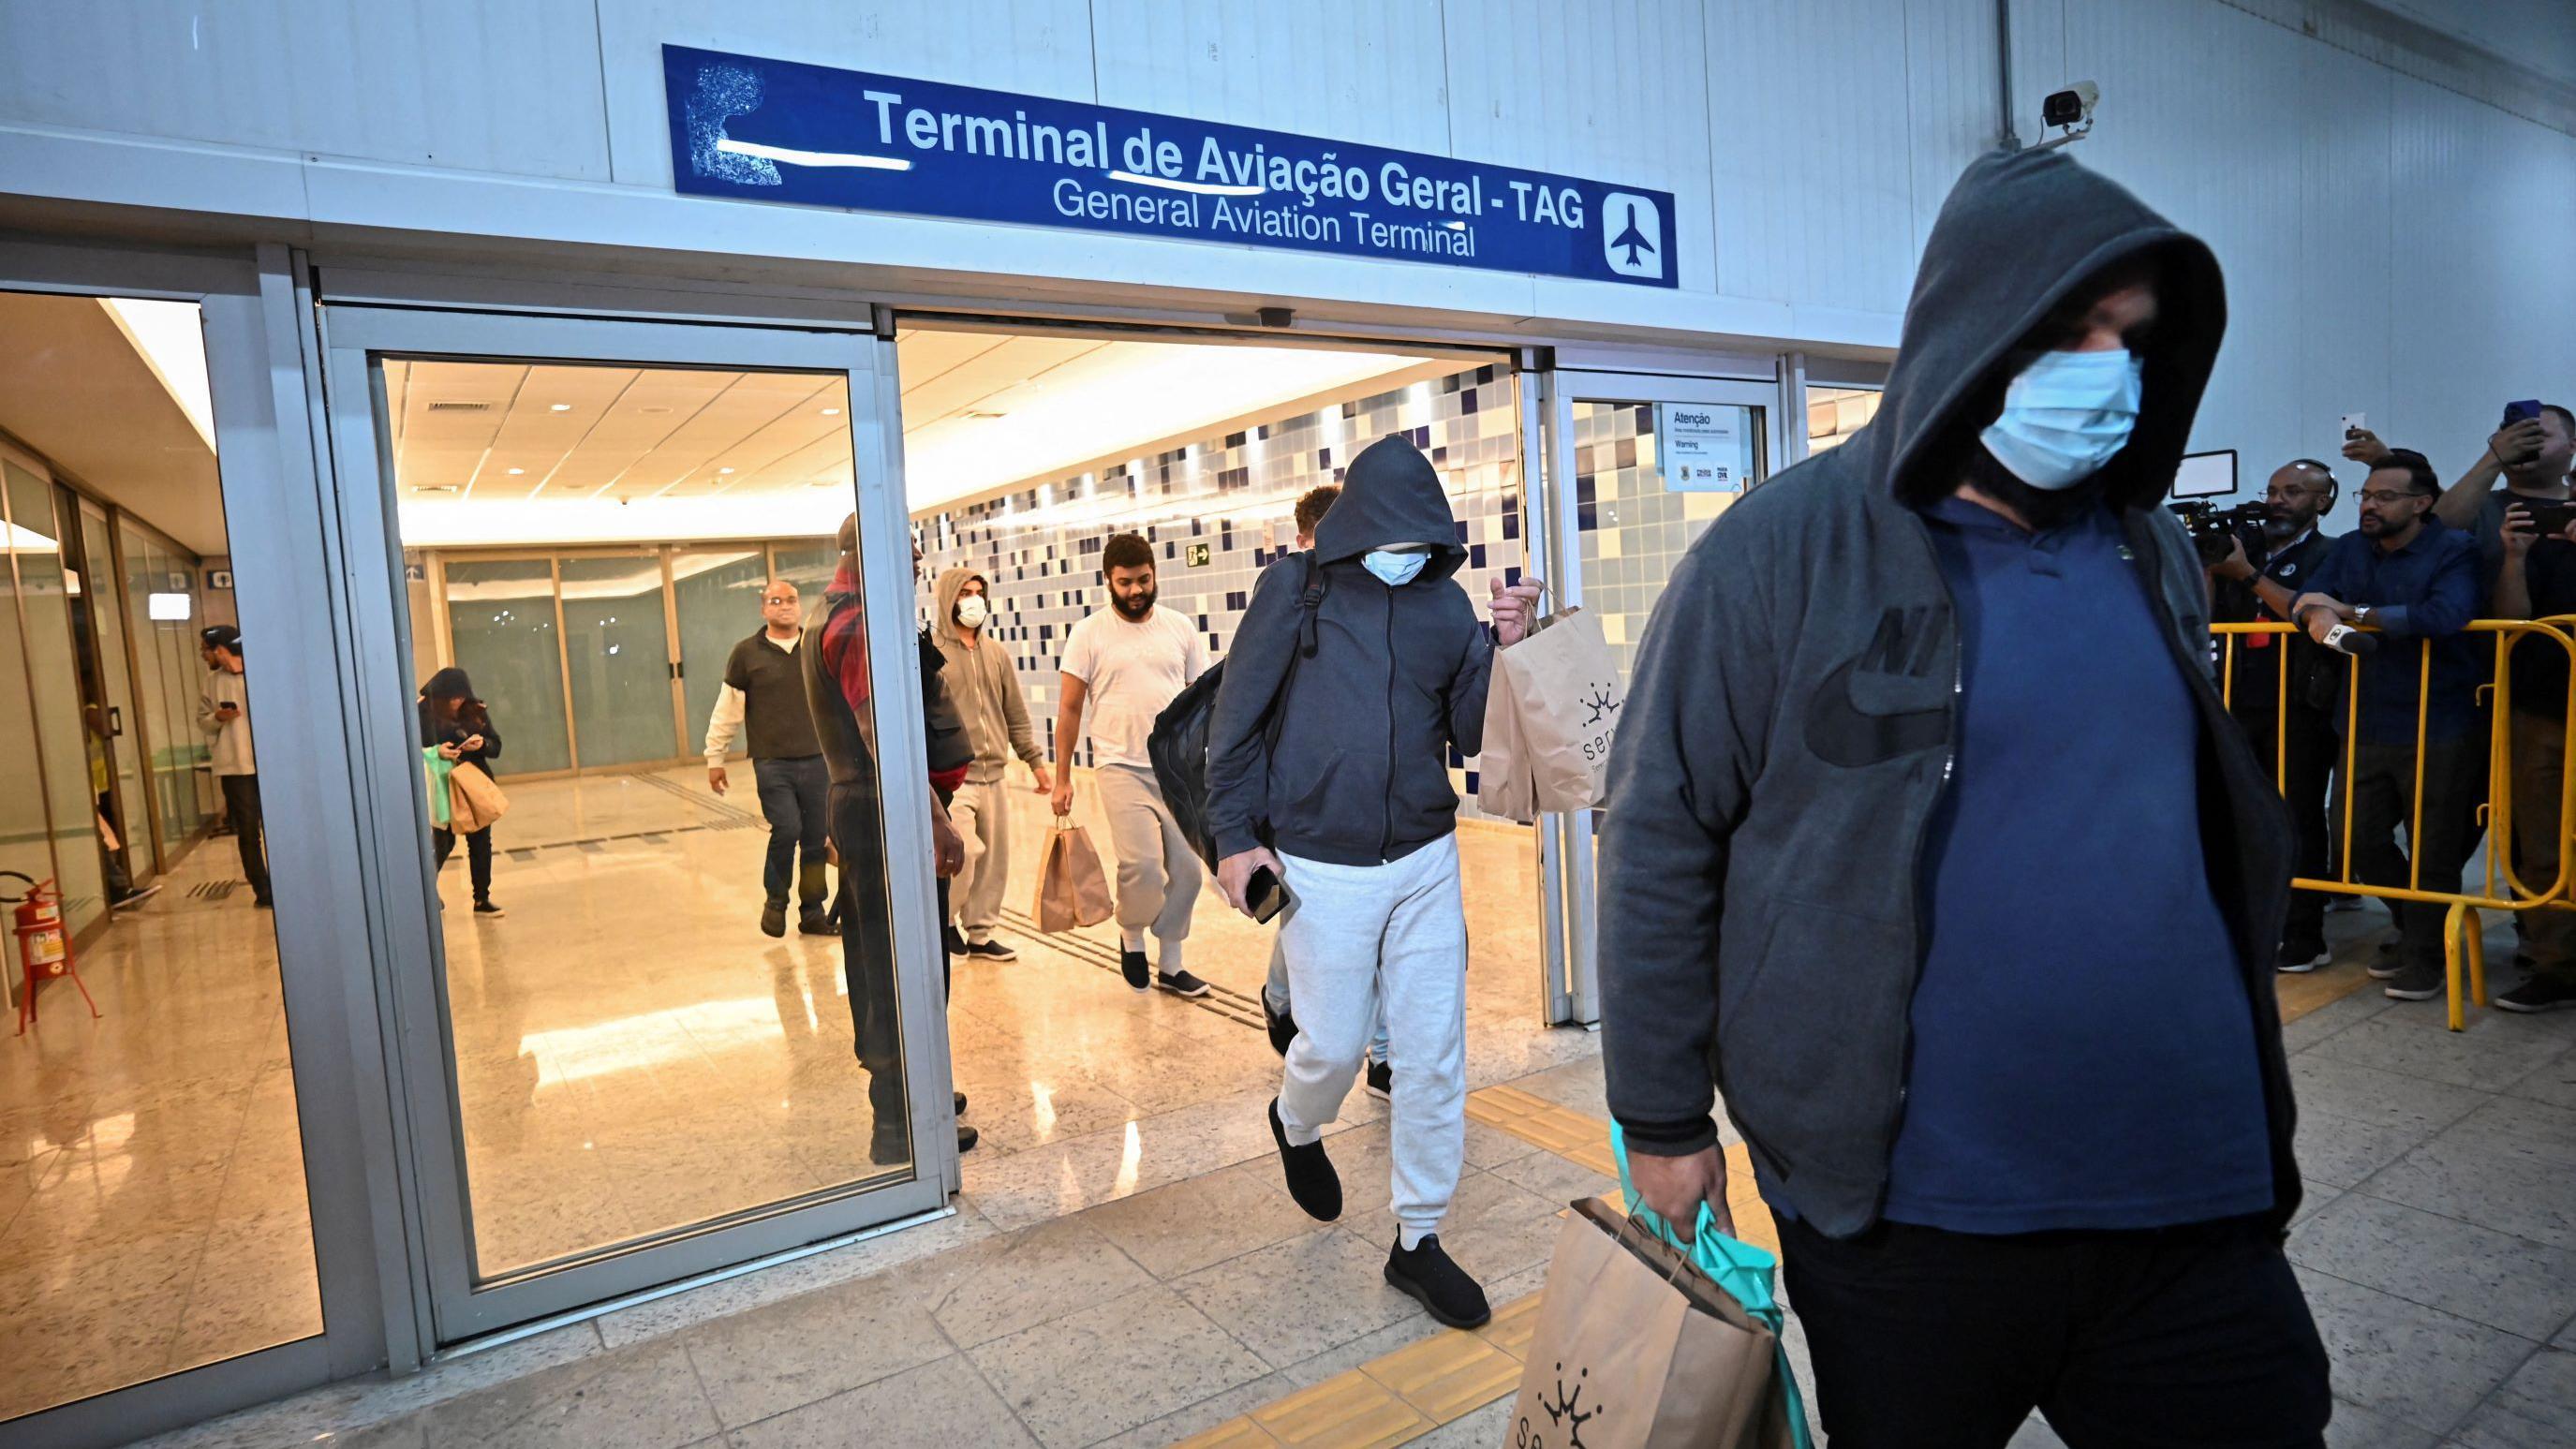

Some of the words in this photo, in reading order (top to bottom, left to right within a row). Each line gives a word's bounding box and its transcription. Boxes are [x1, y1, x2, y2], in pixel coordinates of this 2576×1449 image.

[863, 89, 1109, 170] Terminal
[1123, 127, 1183, 178] de
[1196, 136, 1369, 207] Aviação
[1381, 162, 1482, 216] Geral
[1053, 178, 1200, 229] General
[1211, 196, 1340, 243] Aviation
[1350, 212, 1475, 258] Terminal
[1674, 411, 1710, 427] Atenção
[1675, 439, 1698, 450] Warning
